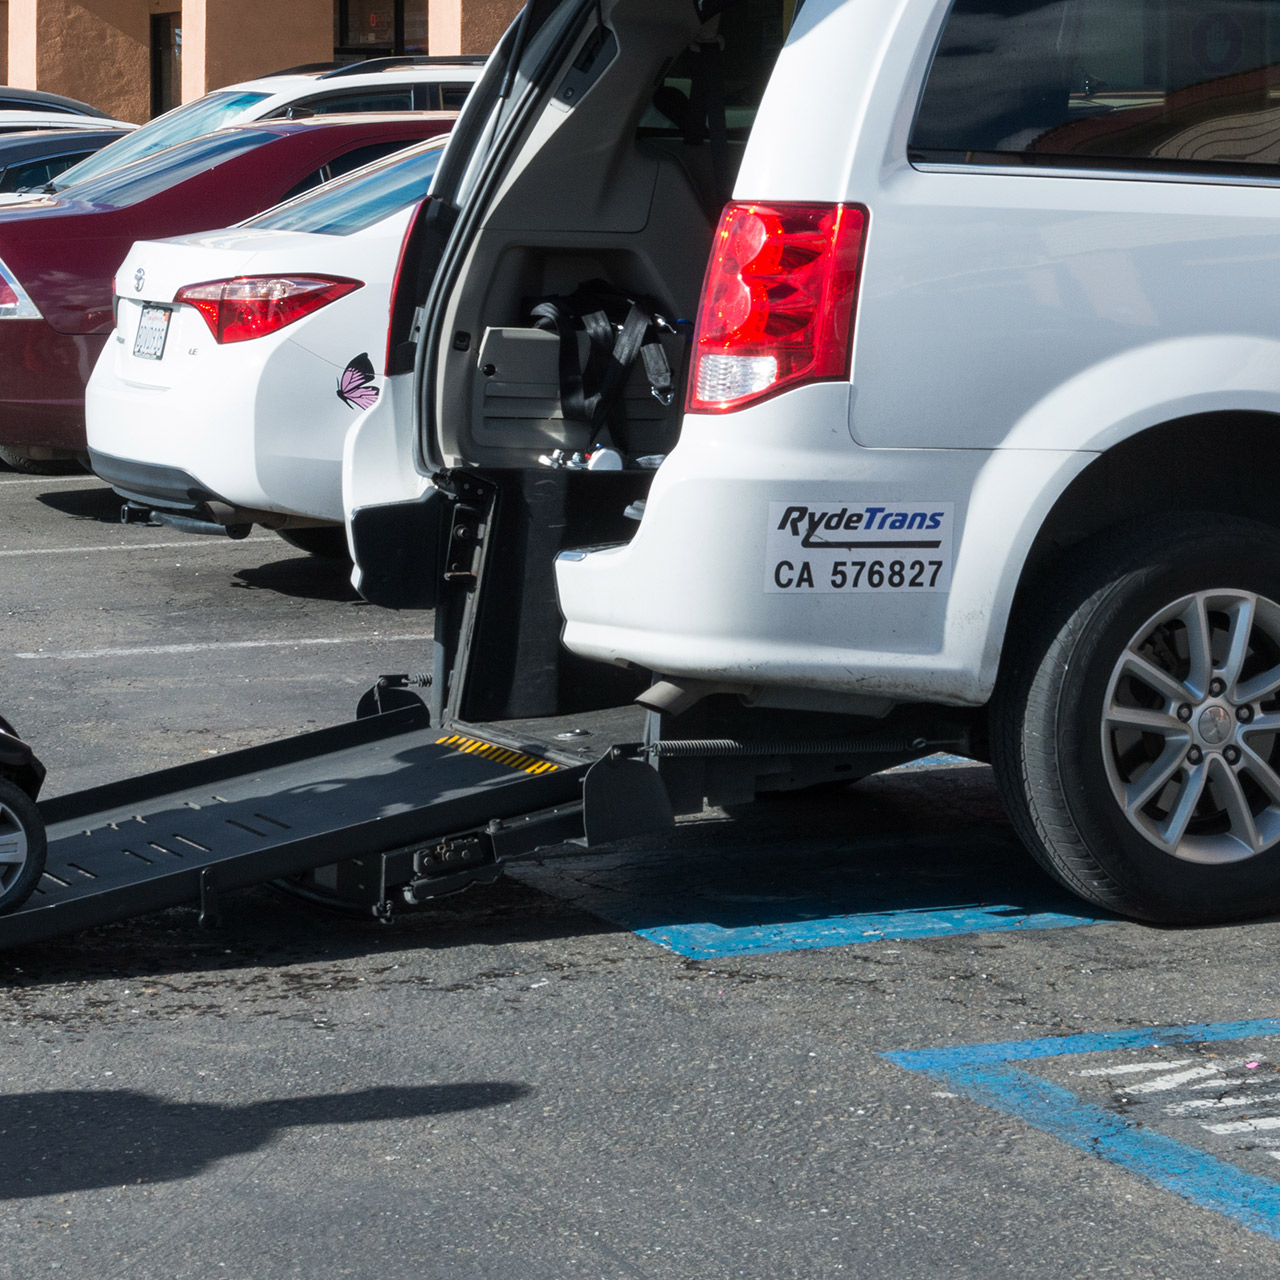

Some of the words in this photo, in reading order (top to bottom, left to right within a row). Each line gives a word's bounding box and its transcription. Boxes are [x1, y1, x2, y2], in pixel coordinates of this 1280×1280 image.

[777, 506, 945, 542] RydeTrans
[774, 560, 815, 589] CA
[830, 560, 944, 589] 576827
